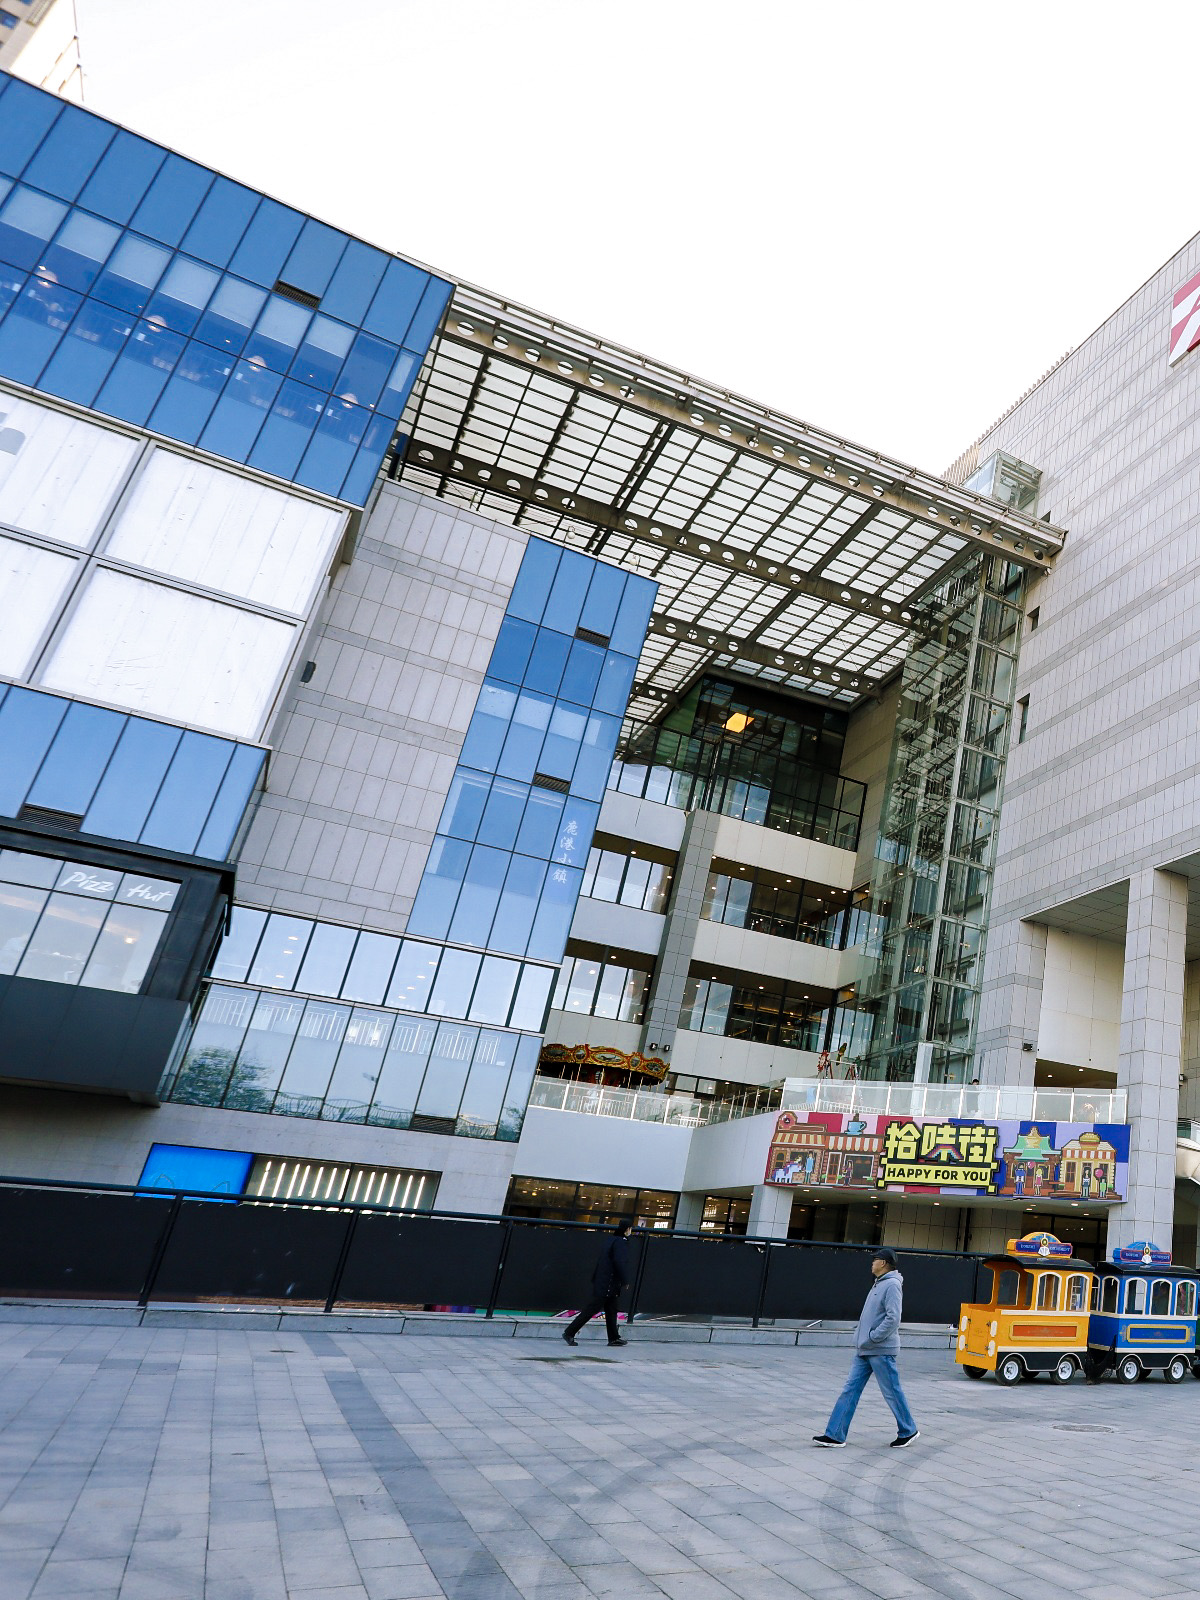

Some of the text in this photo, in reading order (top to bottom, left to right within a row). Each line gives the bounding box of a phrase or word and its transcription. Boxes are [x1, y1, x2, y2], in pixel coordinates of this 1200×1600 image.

[126, 883, 174, 902] Hut
[885, 1122, 997, 1163] 拾味街
[887, 1168, 988, 1182] HAPPY FOR YOU
